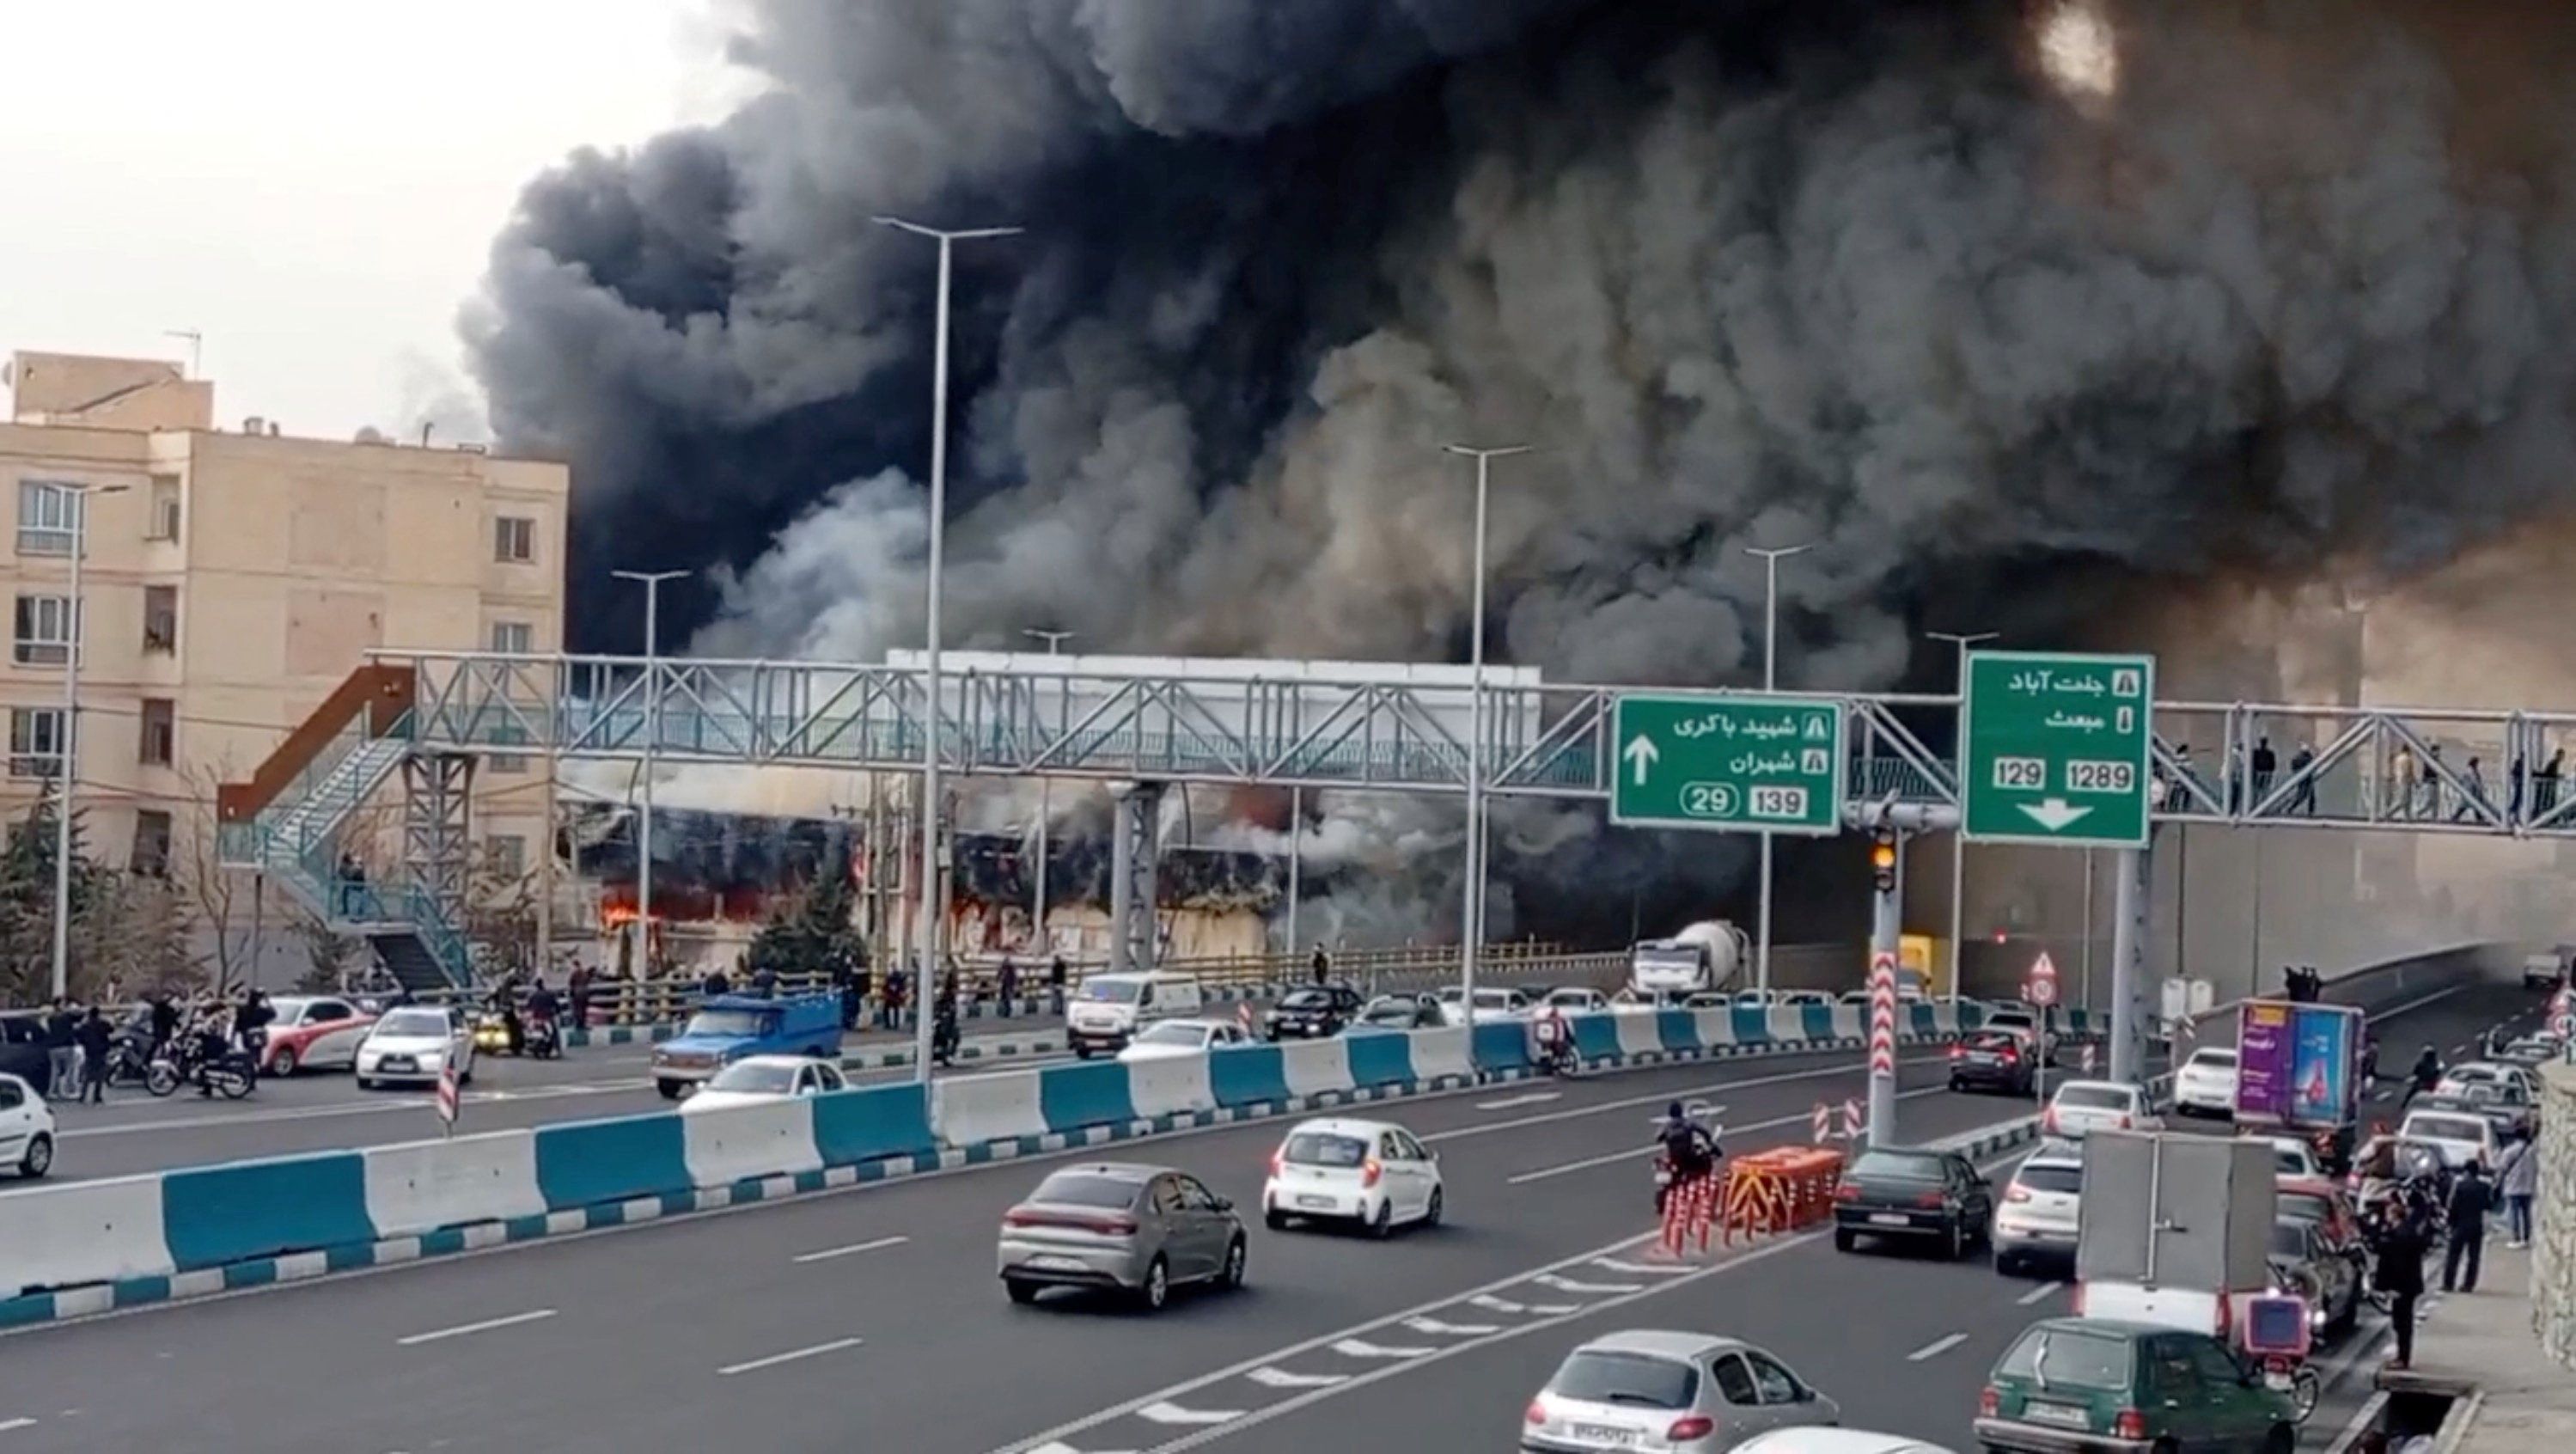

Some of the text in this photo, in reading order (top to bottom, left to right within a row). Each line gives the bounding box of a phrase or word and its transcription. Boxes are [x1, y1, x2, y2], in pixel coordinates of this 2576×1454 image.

[2008, 669, 2053, 696] آباد
[1673, 713, 1798, 739] شهید باکری
[2044, 709, 2105, 734] مبعث
[1730, 750, 1796, 775] شهران
[1999, 761, 2042, 785] 129
[2071, 764, 2131, 789] 1289
[1691, 786, 1729, 811] 29
[1756, 791, 1802, 814] 139
